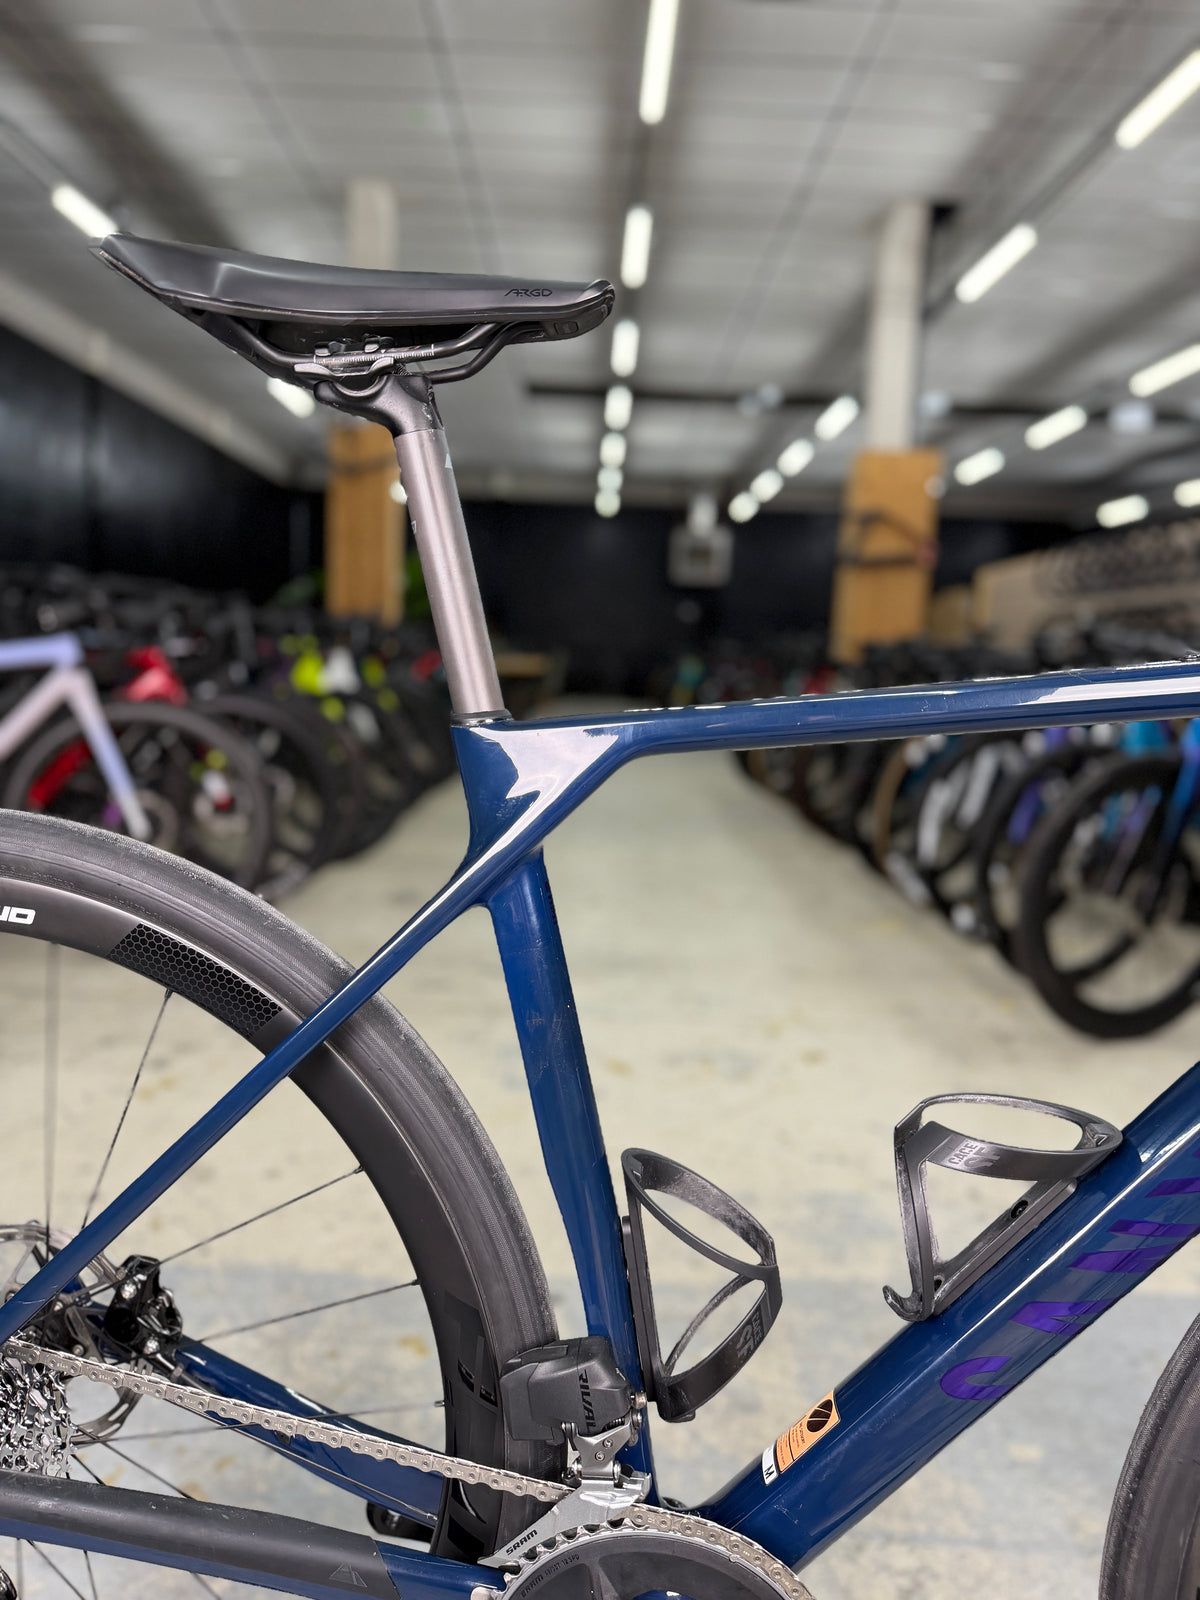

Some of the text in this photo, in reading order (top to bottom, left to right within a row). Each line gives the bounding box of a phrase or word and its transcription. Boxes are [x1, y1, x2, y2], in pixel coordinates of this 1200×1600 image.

[578, 1368, 597, 1434] RIVAL
[764, 1464, 775, 1480] M
[505, 1529, 538, 1556] SRAM
